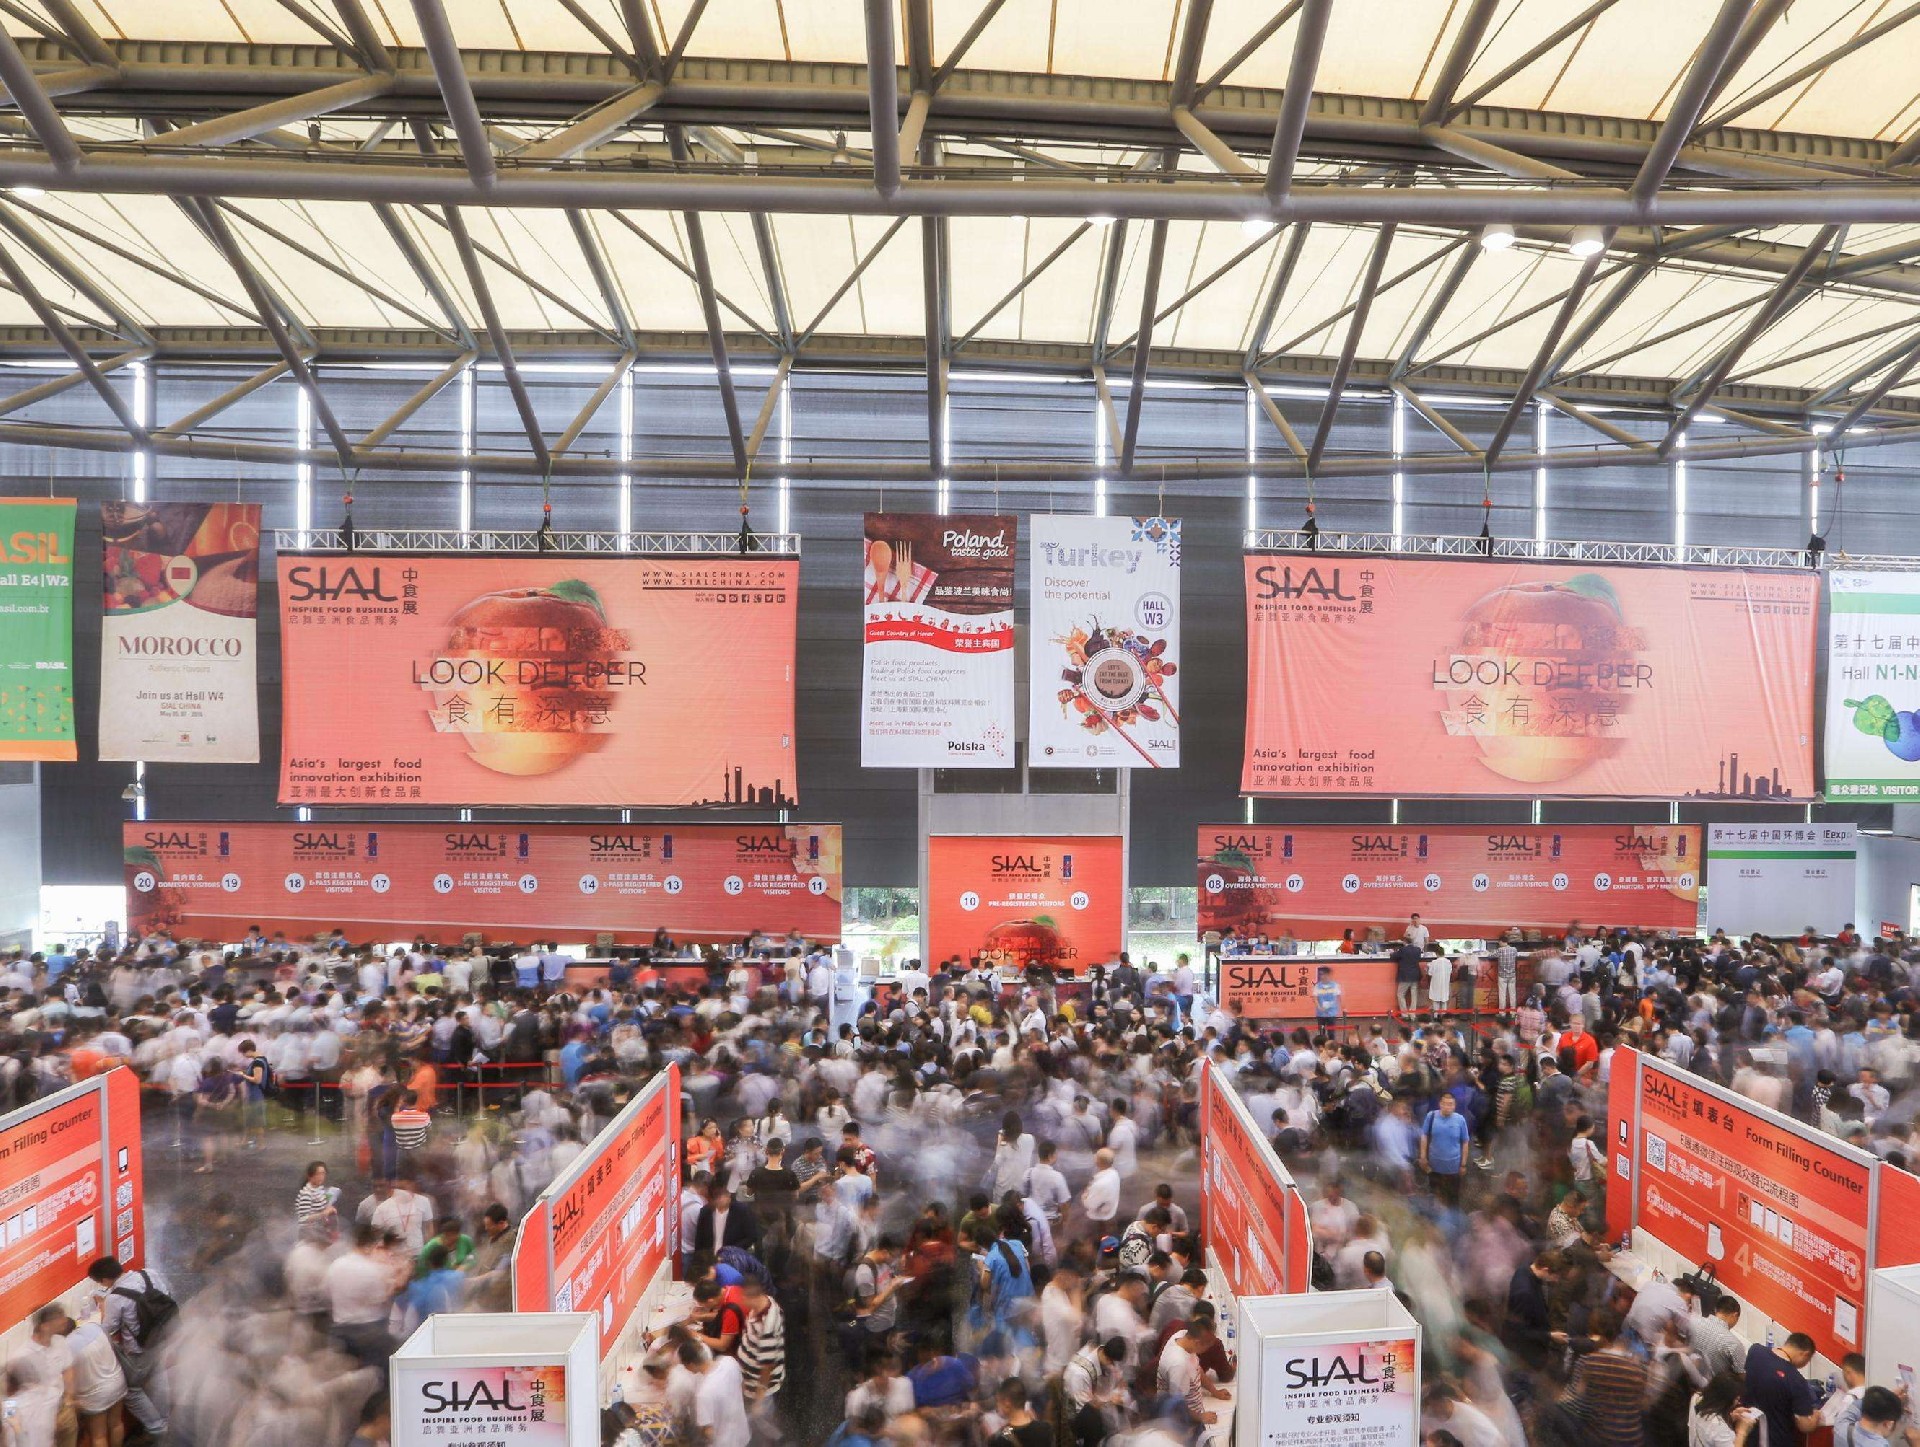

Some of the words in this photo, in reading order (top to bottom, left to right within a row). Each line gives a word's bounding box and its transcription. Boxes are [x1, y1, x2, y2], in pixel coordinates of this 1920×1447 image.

[942, 529, 1005, 549] Poland
[951, 546, 980, 557] tastes
[982, 546, 1009, 560] good
[1039, 542, 1143, 574] Turkey
[288, 566, 399, 602] SIAL
[642, 578, 776, 586] WWW.SIALCHINA.CN
[1044, 577, 1090, 588] Discover
[1255, 565, 1356, 601] SIAL
[402, 567, 419, 616] 中食展
[1044, 589, 1063, 600] the
[1064, 590, 1111, 601] potential
[1359, 569, 1375, 614] 中食展
[288, 606, 324, 614] INSPIRE
[1143, 601, 1165, 611] HALL
[1144, 613, 1164, 625] W3
[118, 635, 242, 657] MOROCCO
[1834, 634, 1920, 651] 第十七届中
[412, 659, 507, 685] LOOK
[518, 660, 648, 686] DEEPER
[1432, 659, 1522, 686] LOOK
[1533, 661, 1653, 688] DEEPER
[1842, 666, 1870, 680] Hall
[1875, 664, 1920, 681] N1-N
[136, 690, 157, 700] Join
[174, 692, 184, 700] at
[186, 691, 205, 701] Hall
[208, 691, 224, 701] W4
[441, 693, 613, 726] 食有深意
[1460, 694, 1620, 727] 食有深意
[948, 741, 986, 751] Polska
[1148, 739, 1171, 749] SIAL
[1253, 748, 1287, 759] Asia's
[1298, 748, 1338, 762] largest
[1349, 750, 1375, 760] food
[289, 758, 326, 769] Asia's
[338, 758, 382, 771] largest
[393, 758, 422, 769] food
[1253, 761, 1313, 772] innovation
[1318, 763, 1375, 773] exhibition
[289, 772, 355, 782] innovation
[360, 772, 422, 782] exhibition
[1253, 775, 1374, 787] 亚洲最大创新食品展
[290, 786, 422, 798] 亚洲最大创新食品展
[1881, 785, 1919, 795] VISITOR
[144, 832, 198, 849] SIAL
[292, 832, 346, 850] SIAL
[1714, 829, 1816, 840] 第十七届中国环博会
[445, 833, 498, 851] SIAL
[589, 835, 642, 852] SIAL
[736, 836, 788, 852] SIAL
[1214, 835, 1263, 852] SIAL
[1351, 835, 1399, 852] SIAL
[1487, 834, 1533, 851] SIAL
[1615, 835, 1660, 851] SIAL
[991, 855, 1042, 872] SIAL
[138, 878, 151, 887] 20
[225, 879, 238, 888] 19
[288, 879, 301, 888] 18
[375, 879, 387, 888] 17
[437, 880, 450, 889] 16
[522, 880, 535, 889] 15
[582, 881, 595, 890] 14
[666, 881, 680, 890] 13
[727, 881, 740, 890] 12
[811, 882, 823, 891] 11
[1208, 879, 1221, 889] 08
[1288, 879, 1300, 888] 07
[1345, 879, 1357, 889] 06
[1426, 879, 1439, 888] 05
[1474, 878, 1487, 888] 04
[1554, 878, 1566, 887] 03
[1596, 878, 1609, 887] 02
[1681, 878, 1692, 887] 01
[964, 897, 976, 906] 10
[1073, 897, 1086, 906] 09
[969, 947, 1013, 961] LOOK
[1229, 966, 1296, 988] SIAL
[1298, 965, 1309, 997] 中食展
[1644, 1073, 1681, 1108] SIAL
[13, 1129, 48, 1153] Filling
[50, 1107, 94, 1135] Counter
[1745, 1127, 1773, 1151] Form
[1776, 1142, 1810, 1172] Filling
[1814, 1161, 1864, 1195] Counter
[1733, 1242, 1750, 1278] 4
[1285, 1354, 1379, 1390] SIAL
[1381, 1352, 1396, 1393] 中食展
[422, 1379, 527, 1413] SIAL
[1284, 1391, 1316, 1400] INSPIRE
[1343, 1387, 1380, 1396] BUSINESS
[530, 1378, 546, 1423] 中食展
